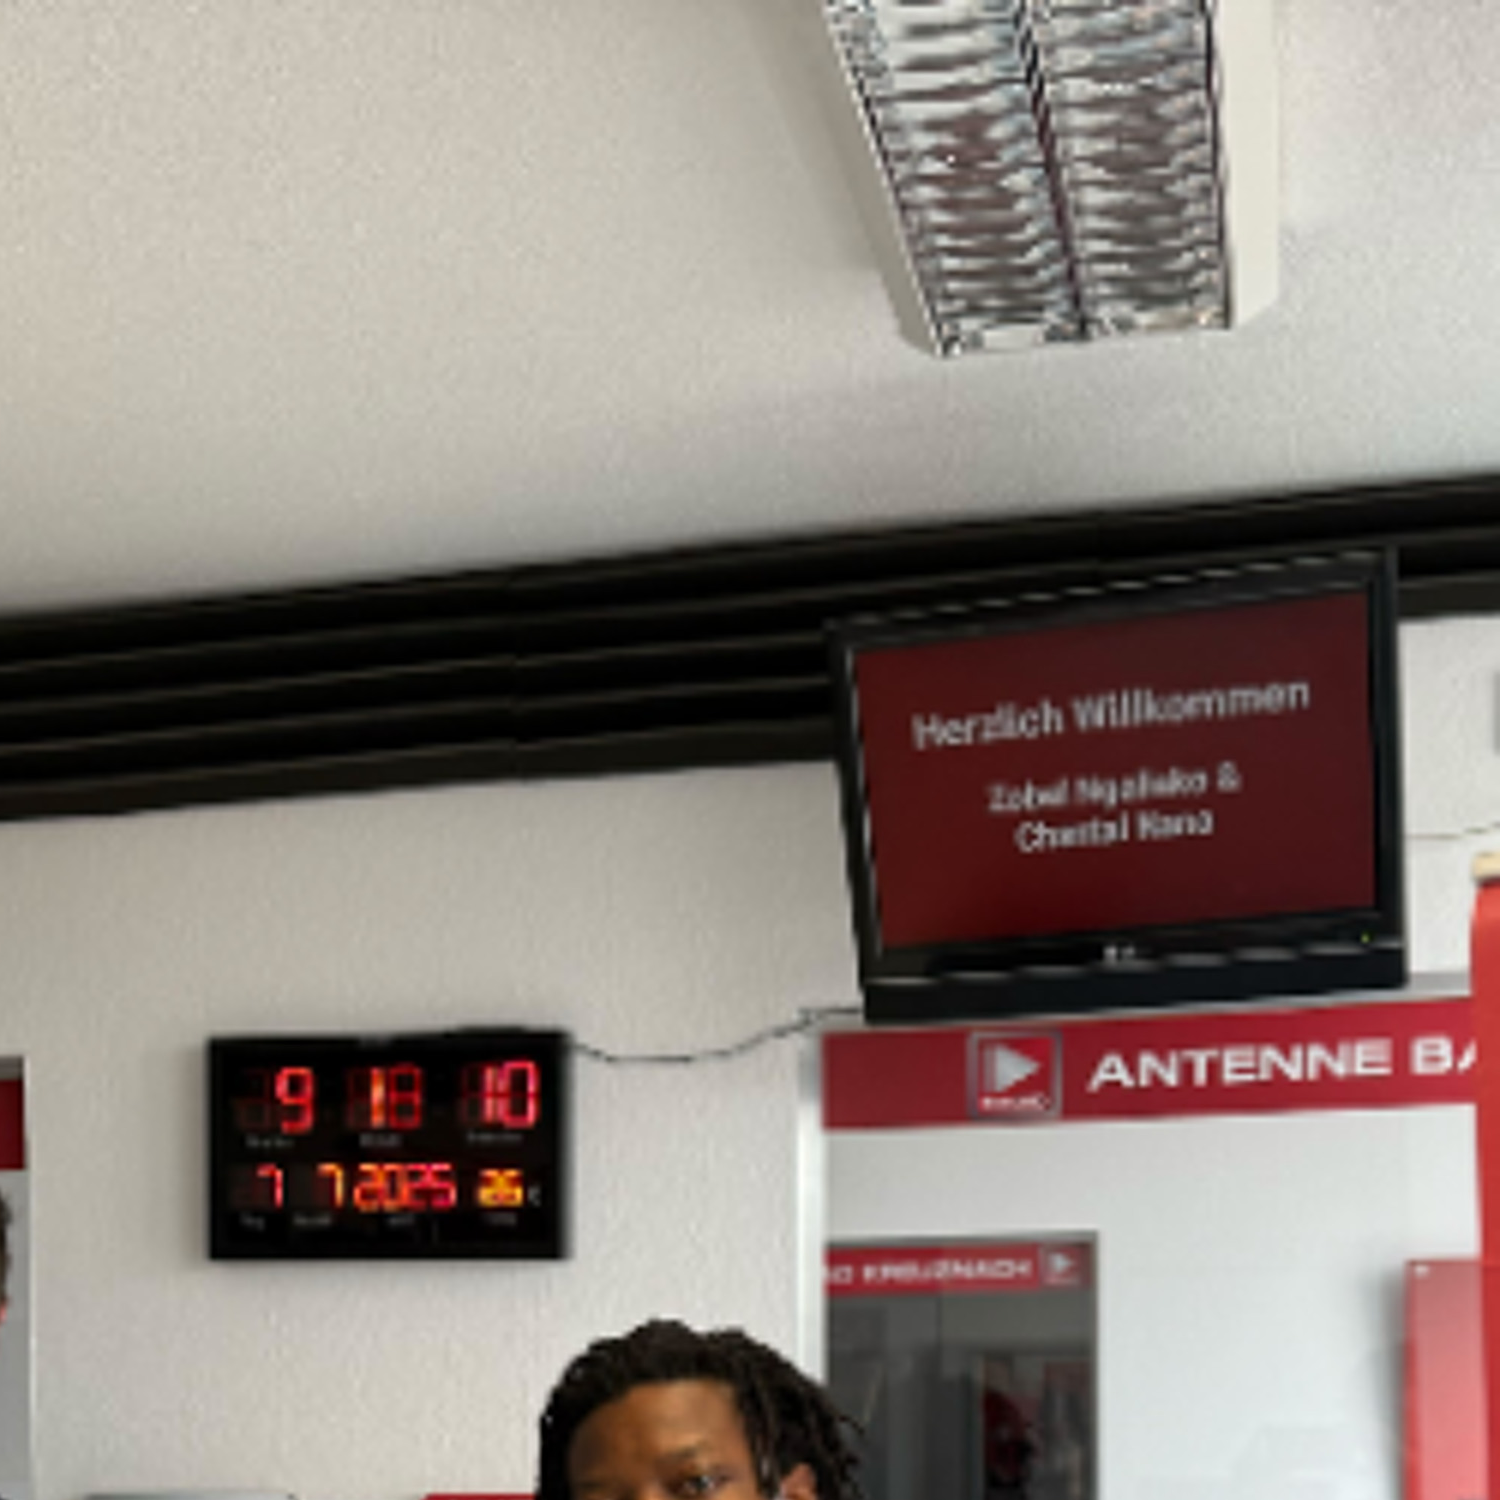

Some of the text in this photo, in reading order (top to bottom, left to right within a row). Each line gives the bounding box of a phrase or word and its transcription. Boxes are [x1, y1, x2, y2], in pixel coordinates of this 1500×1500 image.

[911, 680, 1310, 751] Herzlich Willkommen
[1014, 811, 1129, 852] Chantal
[1087, 1036, 1393, 1094] ANTENNE
[275, 1066, 314, 1134] 9
